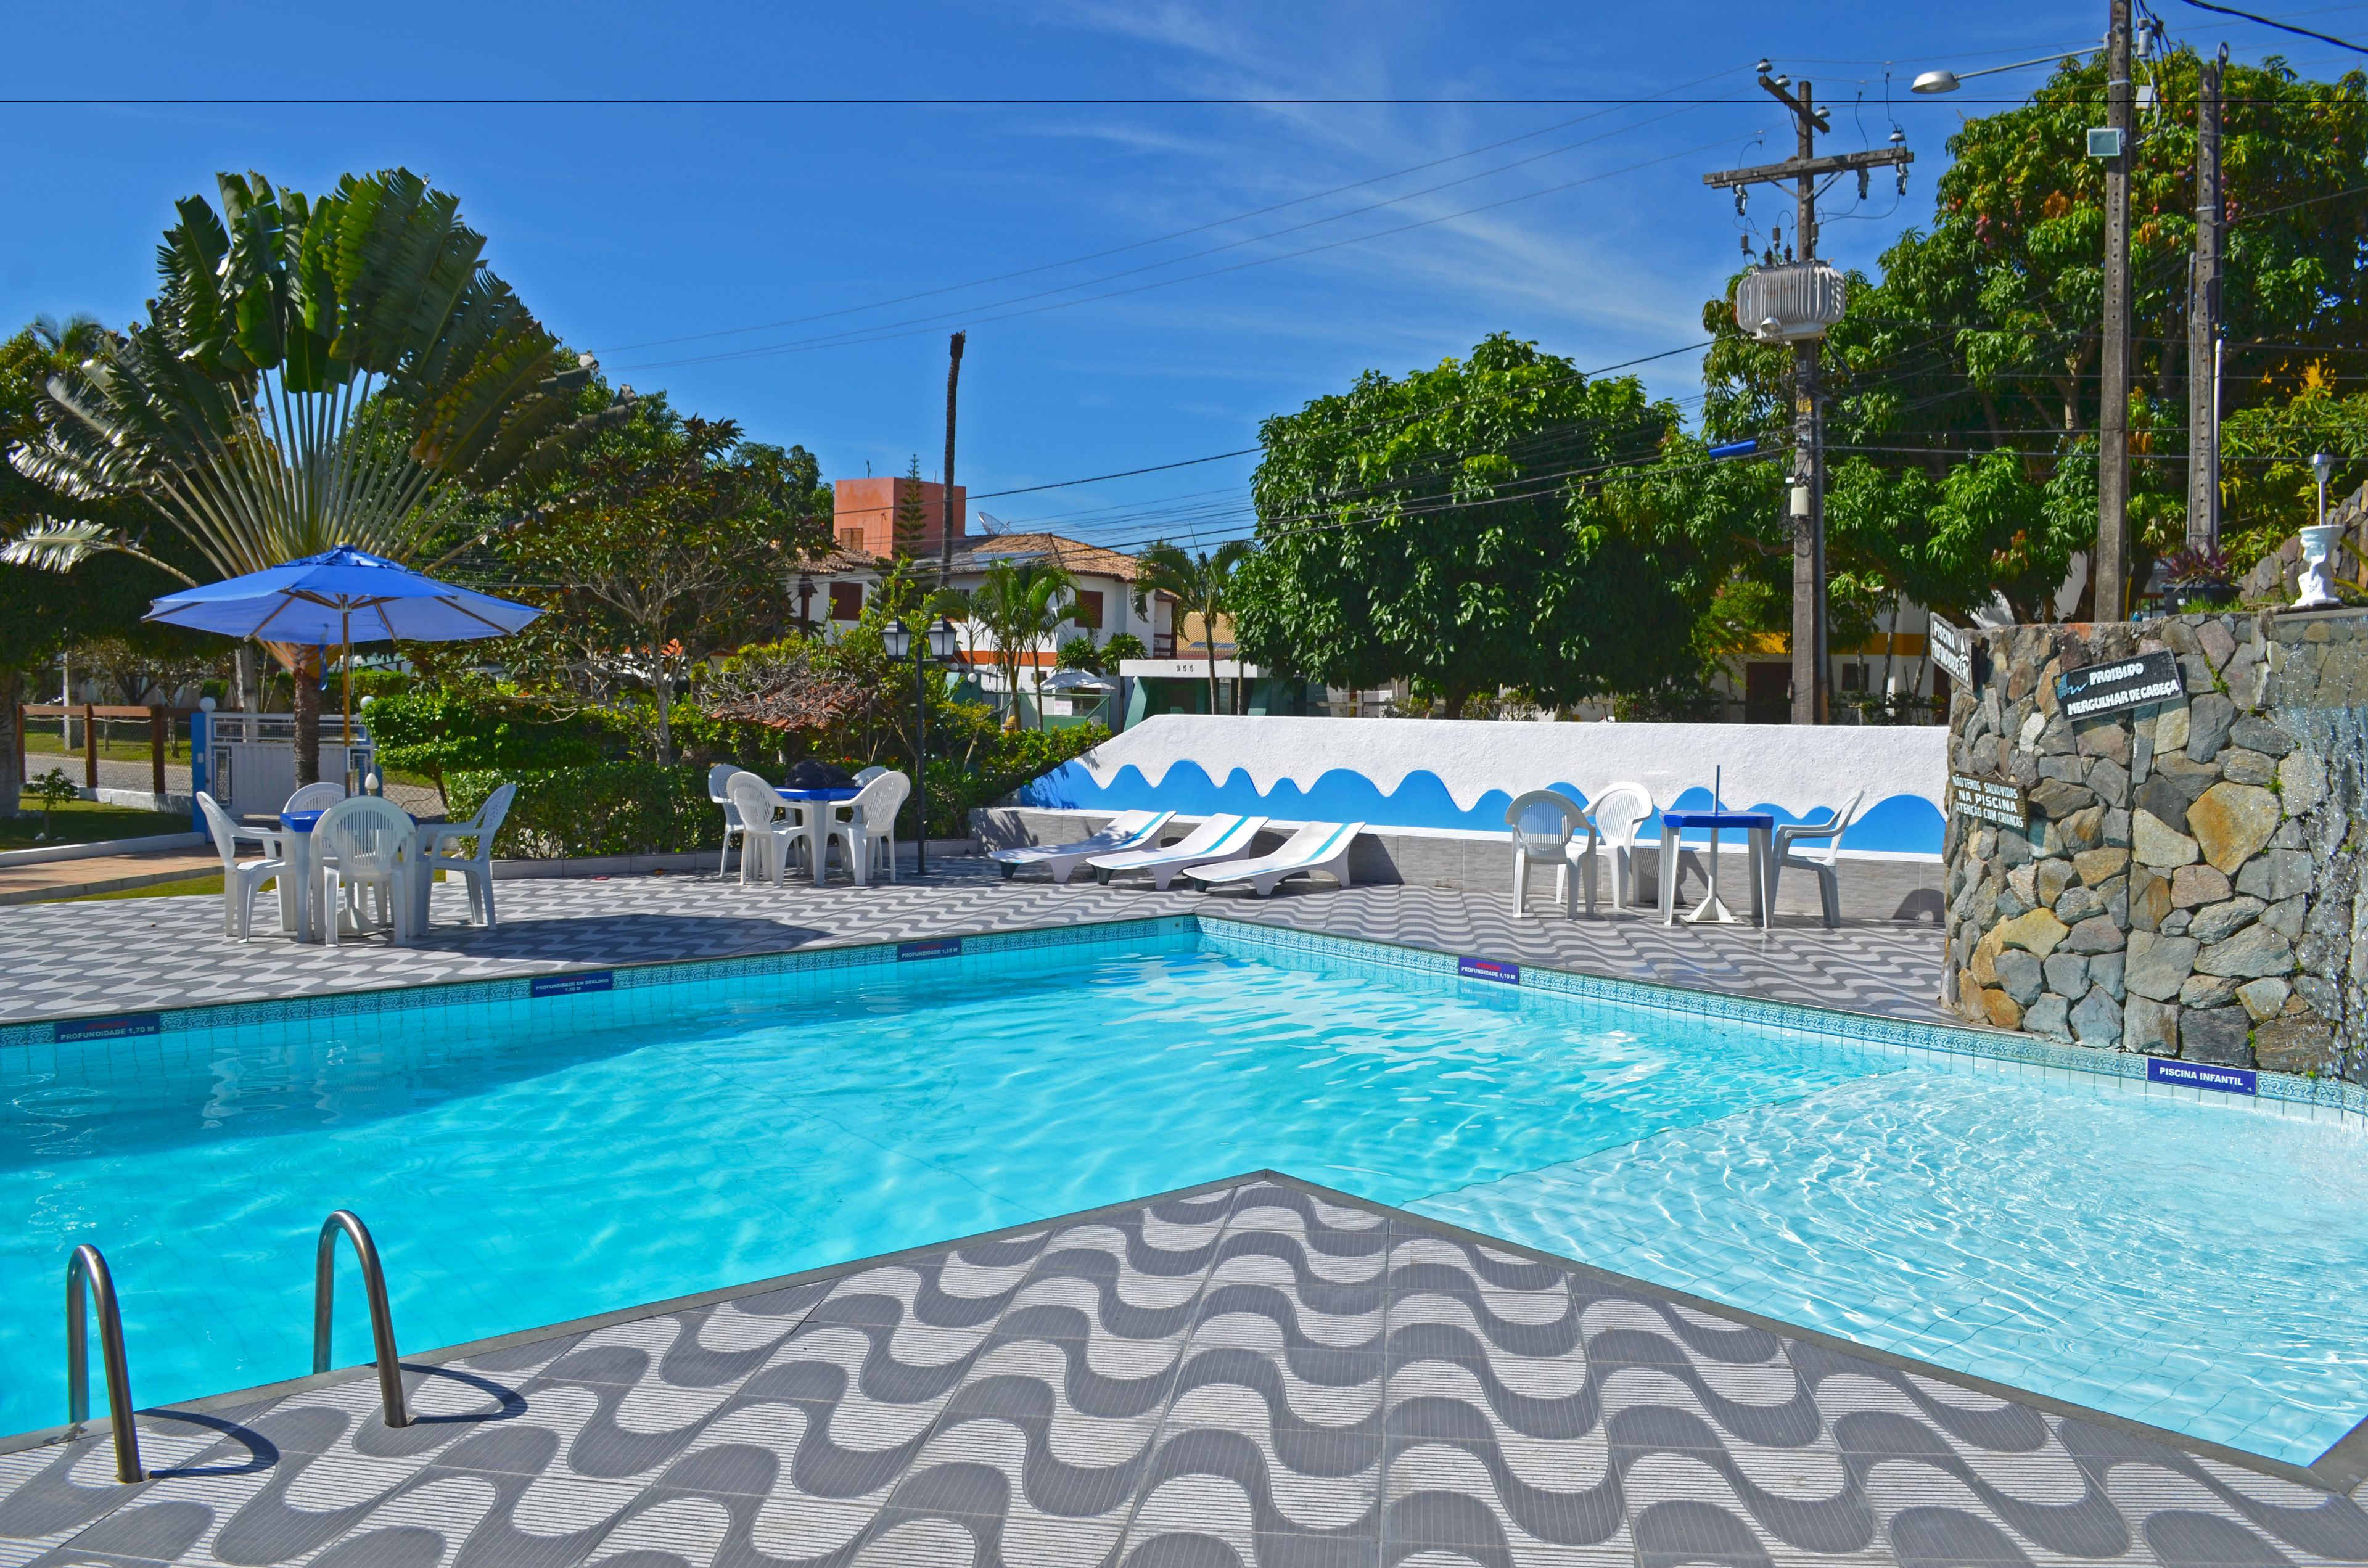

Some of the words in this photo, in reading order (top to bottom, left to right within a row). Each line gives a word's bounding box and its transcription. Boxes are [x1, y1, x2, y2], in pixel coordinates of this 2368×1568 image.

[1934, 620, 1955, 651] PISCINA
[2089, 663, 2144, 686] PROIBIDO
[2067, 691, 2129, 716] MERGULHAR
[2129, 689, 2141, 702] DE
[2140, 679, 2179, 699] CABEÇA
[1952, 774, 1964, 788] NÃO
[1959, 790, 1972, 802] NA
[1975, 793, 2018, 813] PISCINA
[1956, 802, 1982, 818] ATENÇÃO
[1983, 808, 1997, 821] COM
[1997, 811, 2023, 828] CRIANÇAS
[902, 950, 941, 958] PROFUNDIDADE
[1461, 966, 1498, 977] PROFUNDIDADE
[60, 1028, 126, 1040] PROFUNDIDADE
[2160, 1067, 2197, 1079] PISCINA
[2200, 1072, 2243, 1086] INFANTIL
